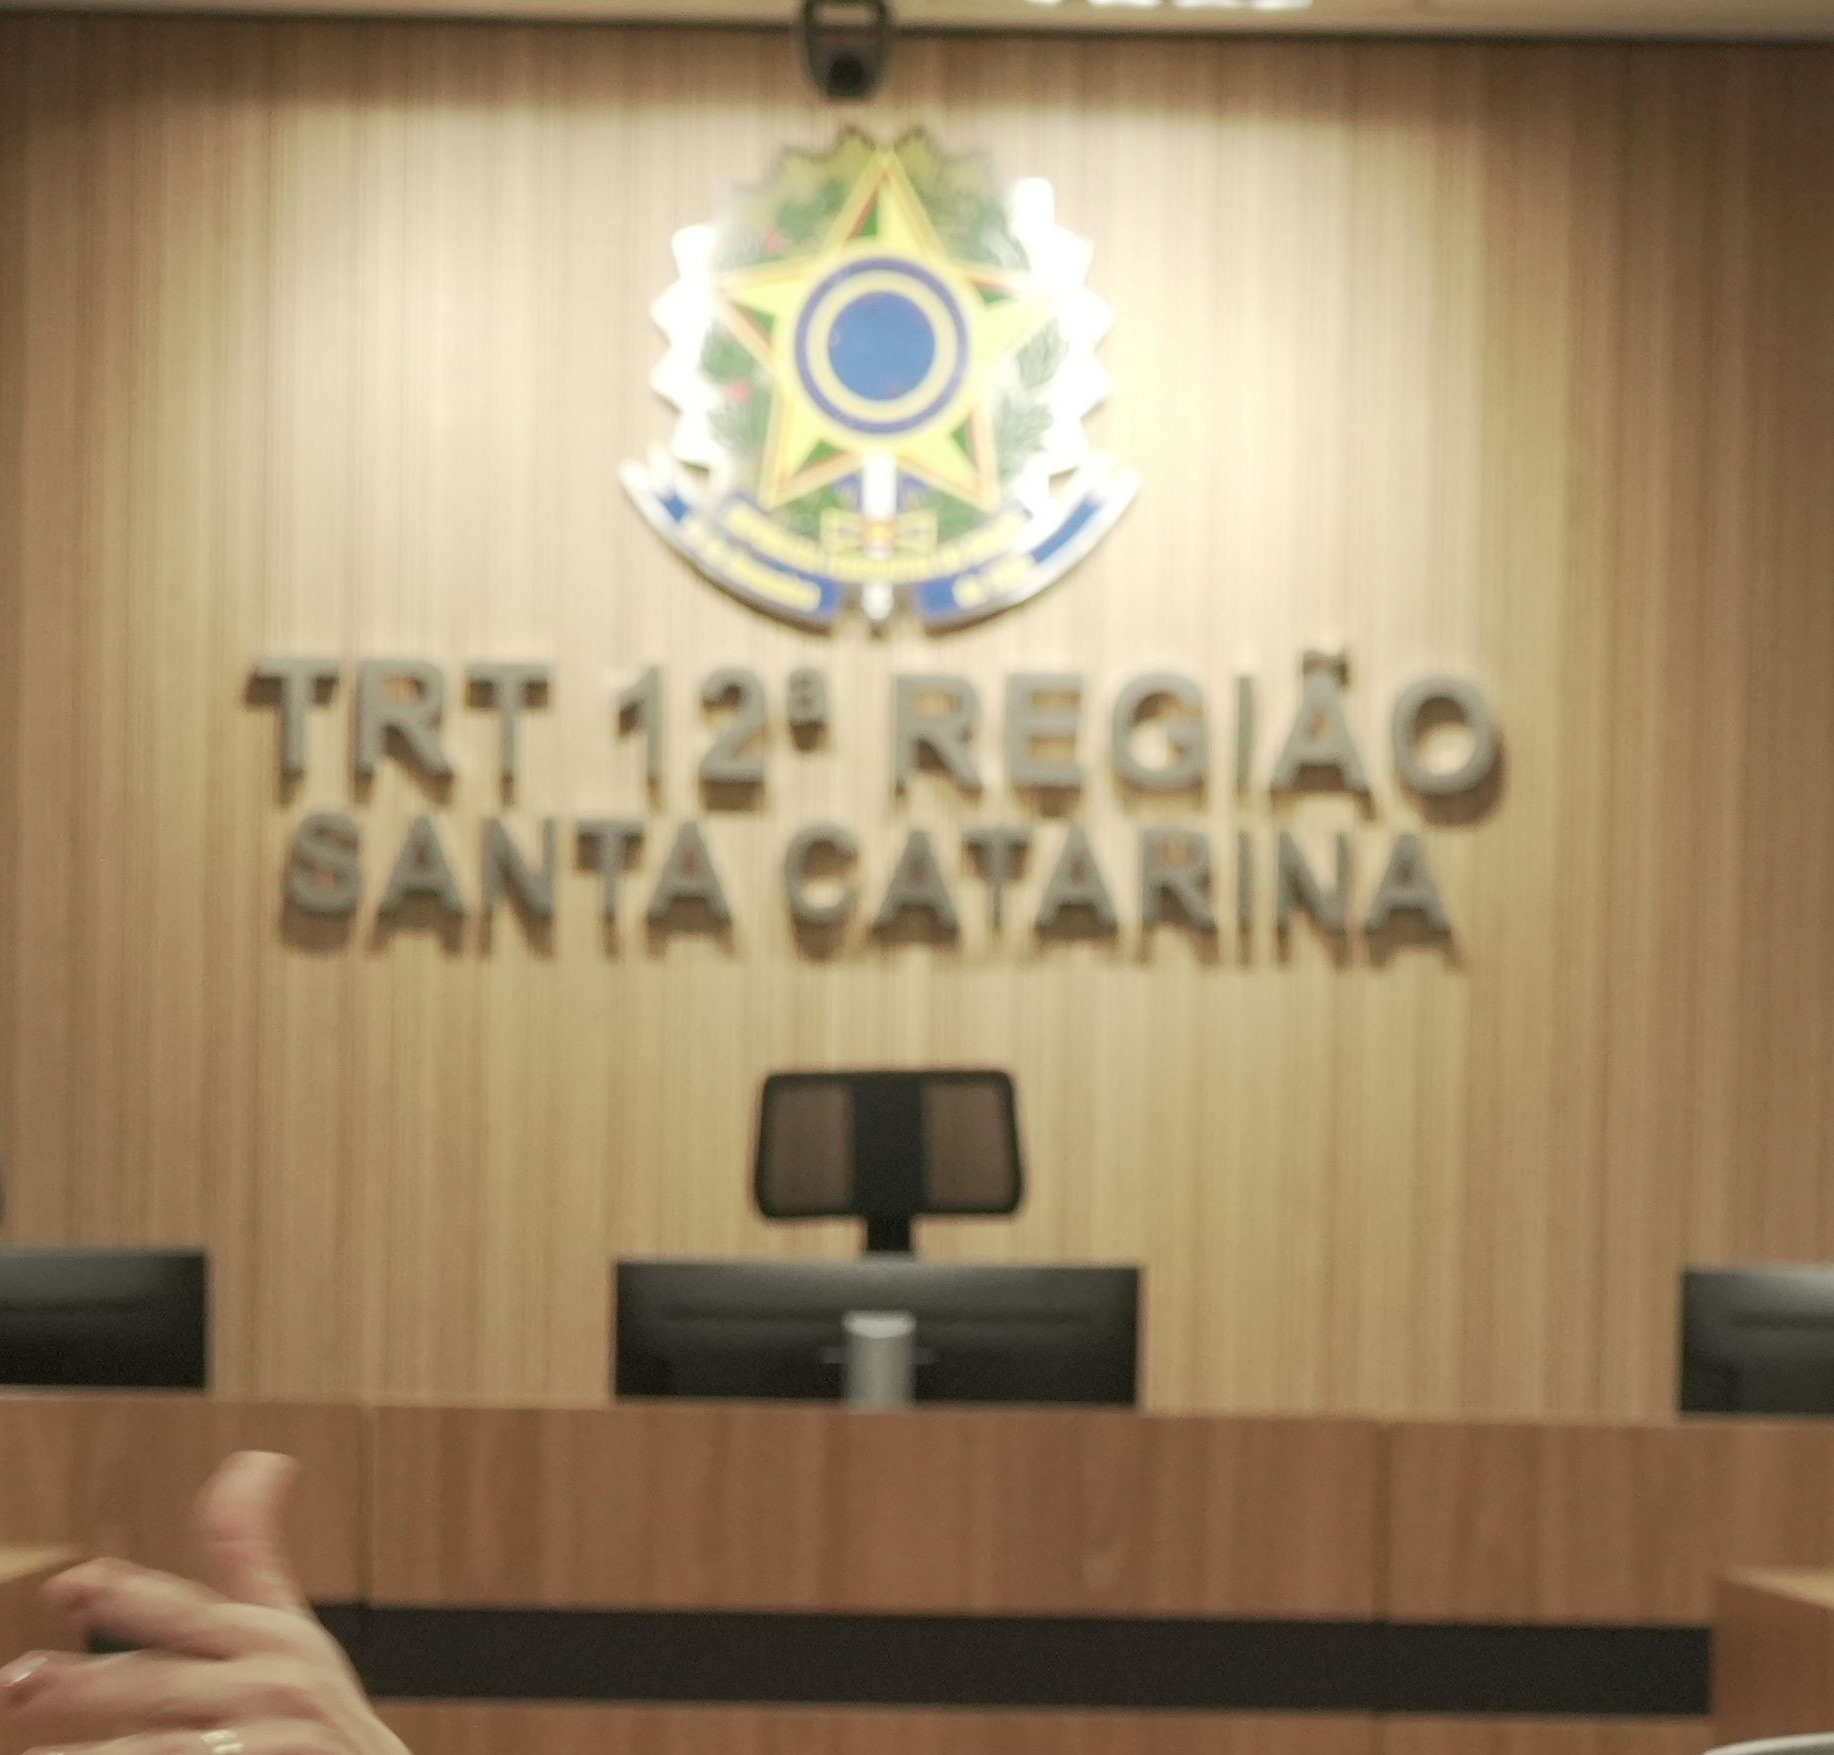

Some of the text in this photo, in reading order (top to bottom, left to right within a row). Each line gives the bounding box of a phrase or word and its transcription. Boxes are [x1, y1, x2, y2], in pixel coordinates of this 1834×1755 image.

[249, 650, 1501, 800] TRT 12ª REGIÃO
[283, 812, 1457, 938] SANTA CATARINA
